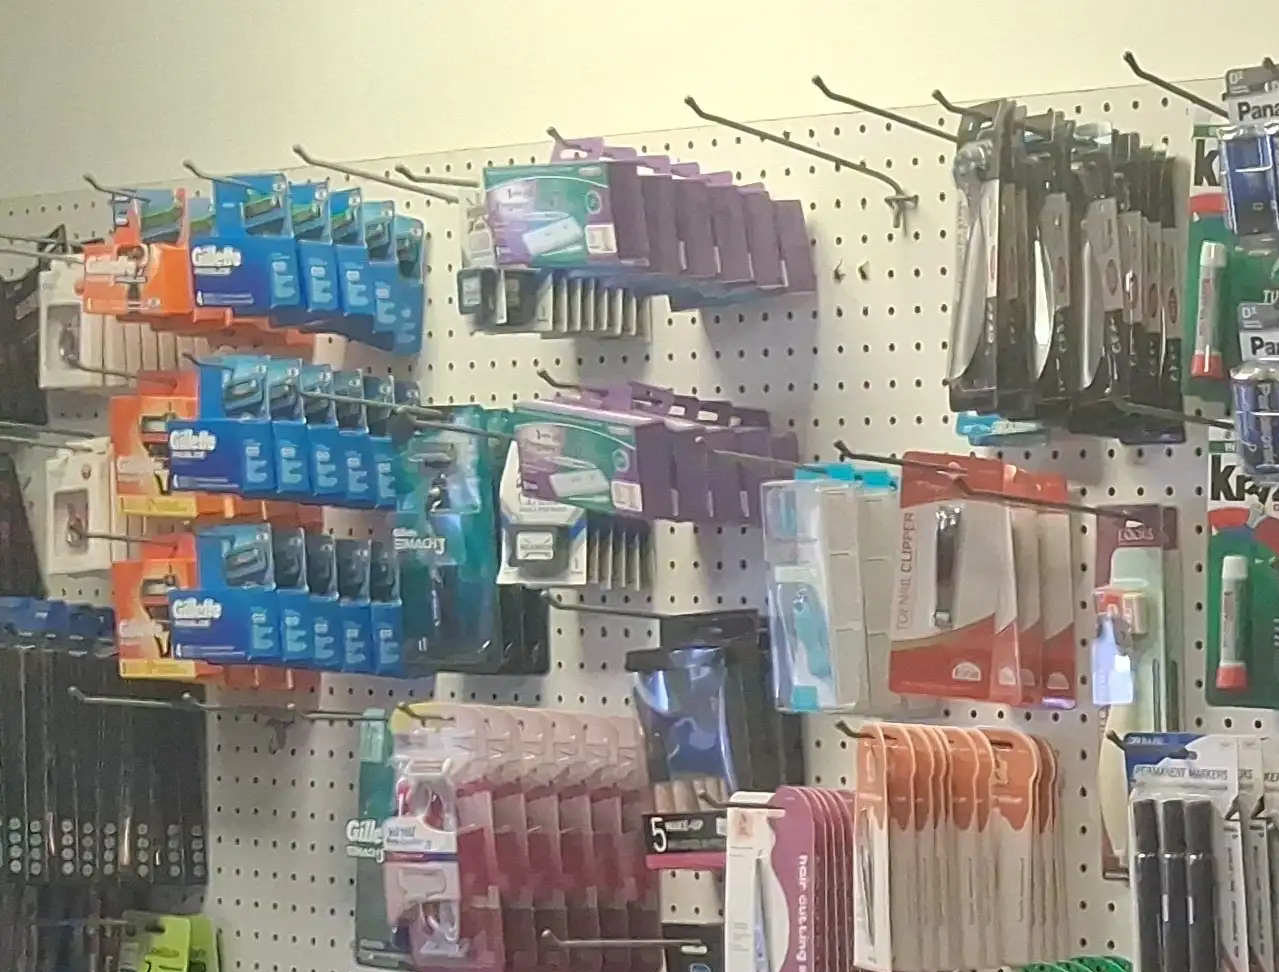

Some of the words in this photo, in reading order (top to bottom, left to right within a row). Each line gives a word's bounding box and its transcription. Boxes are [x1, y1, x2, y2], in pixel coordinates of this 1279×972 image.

[901, 512, 917, 574] CLIPPER
[1135, 765, 1187, 780] PERMANENT
[1188, 769, 1229, 782] MARKERS
[651, 816, 666, 852] 5
[797, 854, 810, 891] hair
[797, 894, 811, 963] cutting
